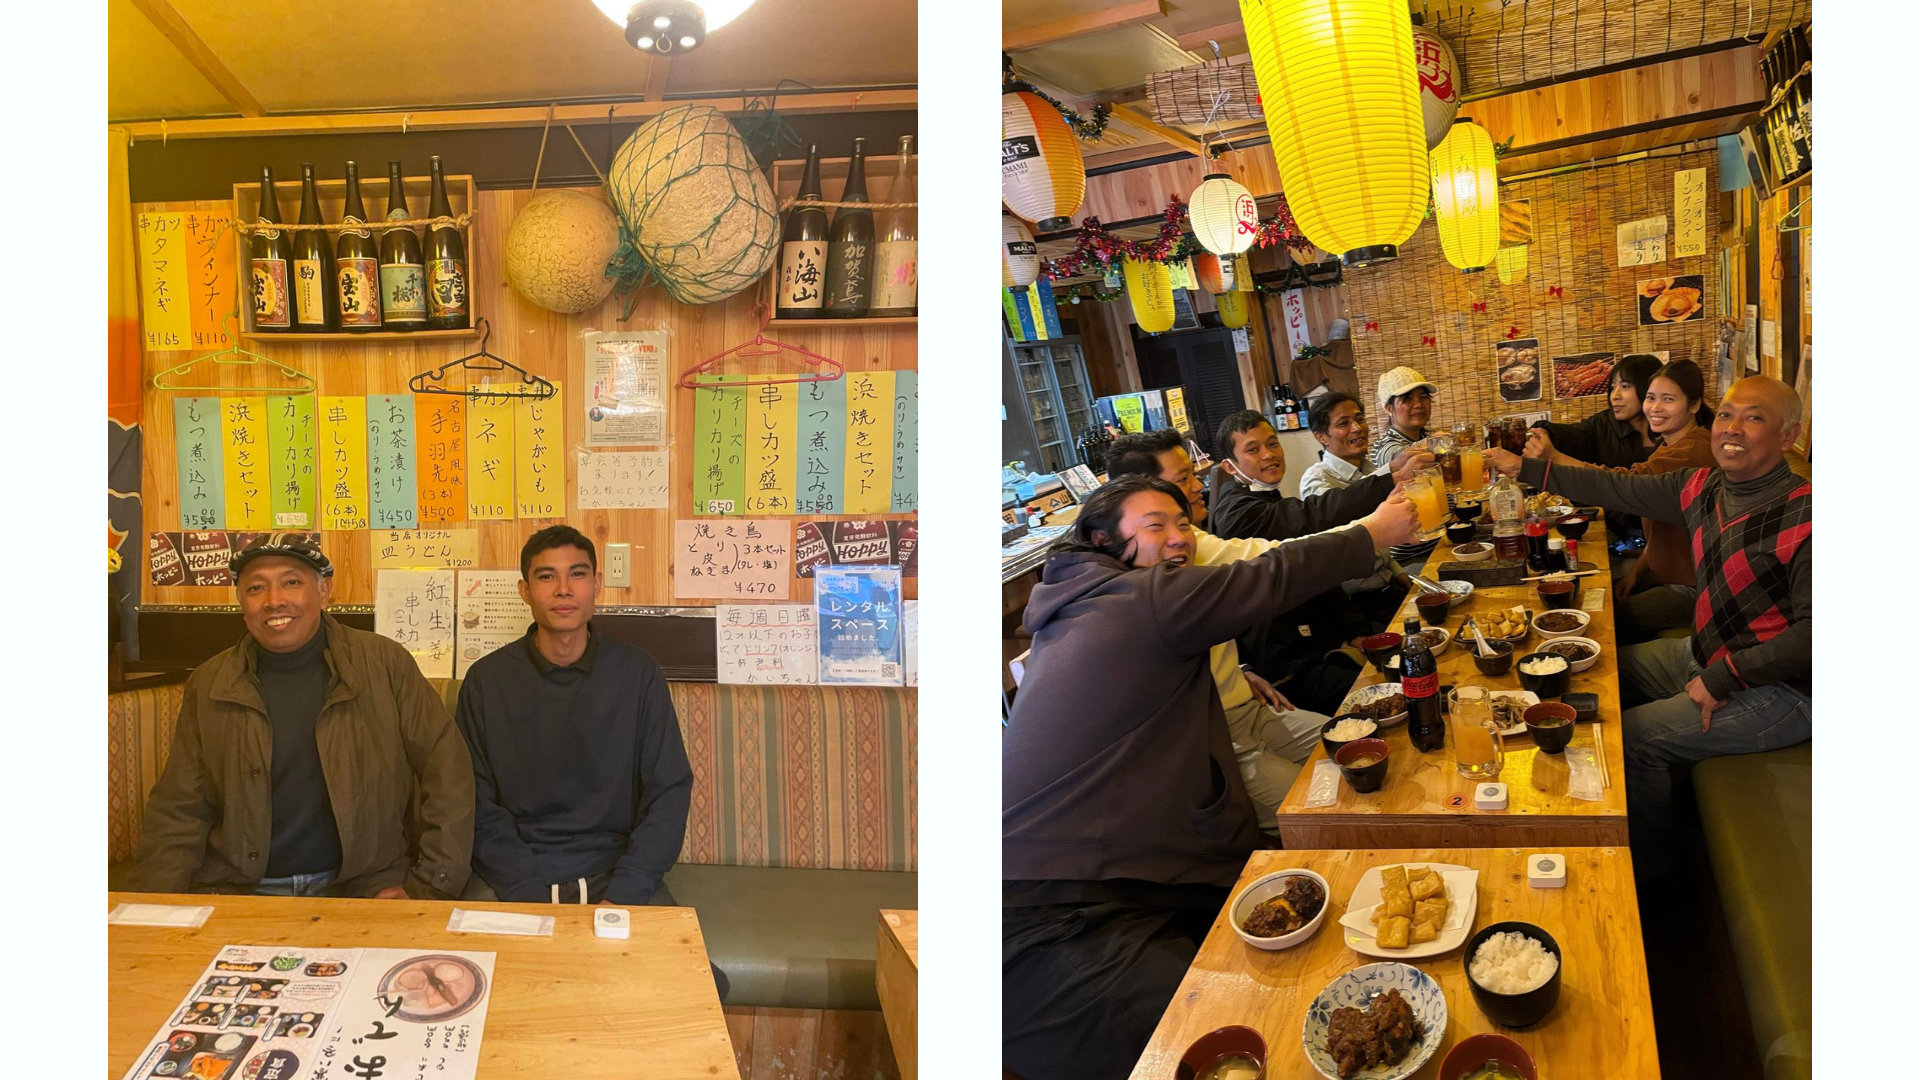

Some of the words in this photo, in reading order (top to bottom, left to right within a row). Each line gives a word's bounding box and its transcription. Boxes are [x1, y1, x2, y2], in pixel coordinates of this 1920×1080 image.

[1694, 181, 1704, 231] オニオン
[139, 214, 181, 235] 串カツ
[152, 237, 172, 314] タマネギ
[791, 246, 821, 303] 八海山
[1286, 293, 1304, 340] ホッピー
[147, 331, 180, 346] ¥165
[194, 331, 228, 346] ¥110
[728, 396, 743, 465] チーズの
[759, 383, 783, 491] 串しカツ盛
[807, 380, 830, 494] もつ煮込み
[850, 378, 878, 495] 浜焼きセット
[188, 402, 207, 500] もつ煮込み
[300, 413, 314, 475] チーズの
[388, 404, 408, 494] お茶漬け
[428, 409, 448, 483] 手羽先
[447, 399, 464, 486] 名古屋風味
[475, 418, 501, 481] ネギ
[707, 385, 725, 497] カリカリ揚げ
[228, 402, 258, 519] 浜焼きセット
[283, 401, 301, 511] カリカリ揚げ
[328, 405, 352, 500] 串しカツ盛
[422, 488, 453, 500] (3本)
[746, 496, 788, 511] (6本)
[894, 492, 919, 509] ¥4
[326, 503, 358, 517] (6本)
[378, 508, 413, 524] ¥450
[419, 505, 455, 519] ¥500
[470, 504, 504, 517] ¥110
[520, 503, 553, 515] ¥110
[693, 521, 762, 541] 焼き鳥
[380, 544, 452, 560] 皿うどん
[687, 540, 725, 553] とり
[444, 558, 473, 567] ¥1200
[701, 552, 718, 567] 皮
[155, 566, 179, 582] ホッピー
[194, 572, 228, 586] ホッピー
[690, 564, 730, 577] ねぎま
[734, 581, 776, 594] ¥470
[831, 600, 892, 613] レンタル
[425, 575, 450, 663] 紅生姜
[830, 618, 889, 631] スペース
[1451, 796, 1463, 806] 2
[344, 995, 404, 1080] おでん
